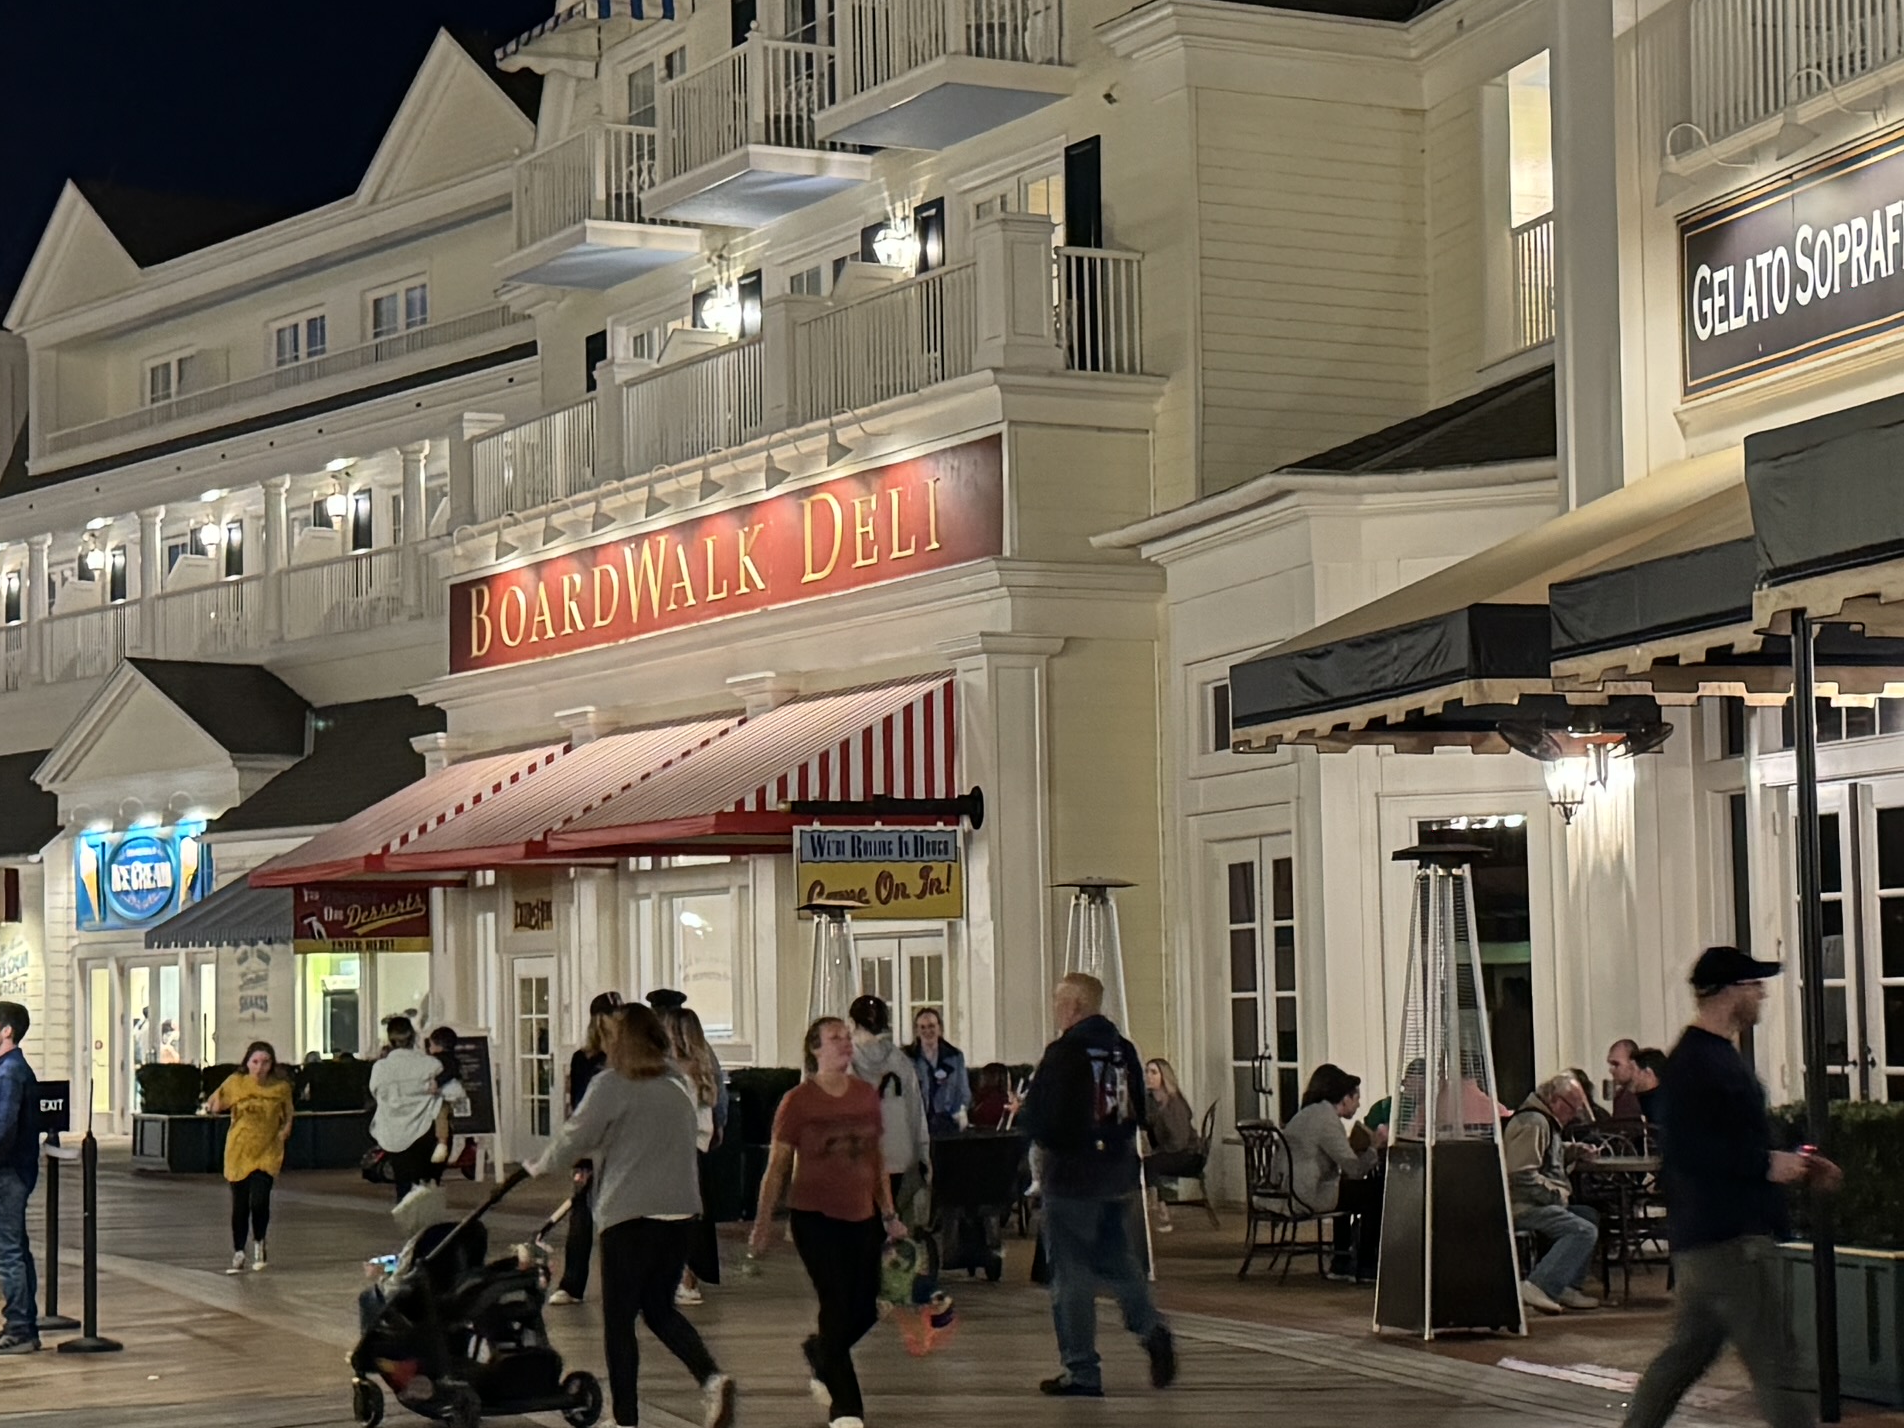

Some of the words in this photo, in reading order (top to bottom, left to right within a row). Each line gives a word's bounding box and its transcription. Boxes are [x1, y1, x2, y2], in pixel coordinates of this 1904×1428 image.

[1692, 245, 1790, 341] GELATO
[469, 522, 766, 659] BOARDWALK
[798, 476, 942, 585] DELI
[875, 870, 910, 905] On
[914, 863, 952, 900] In!
[343, 893, 426, 929] Desserts
[39, 1099, 64, 1112] EXIT
